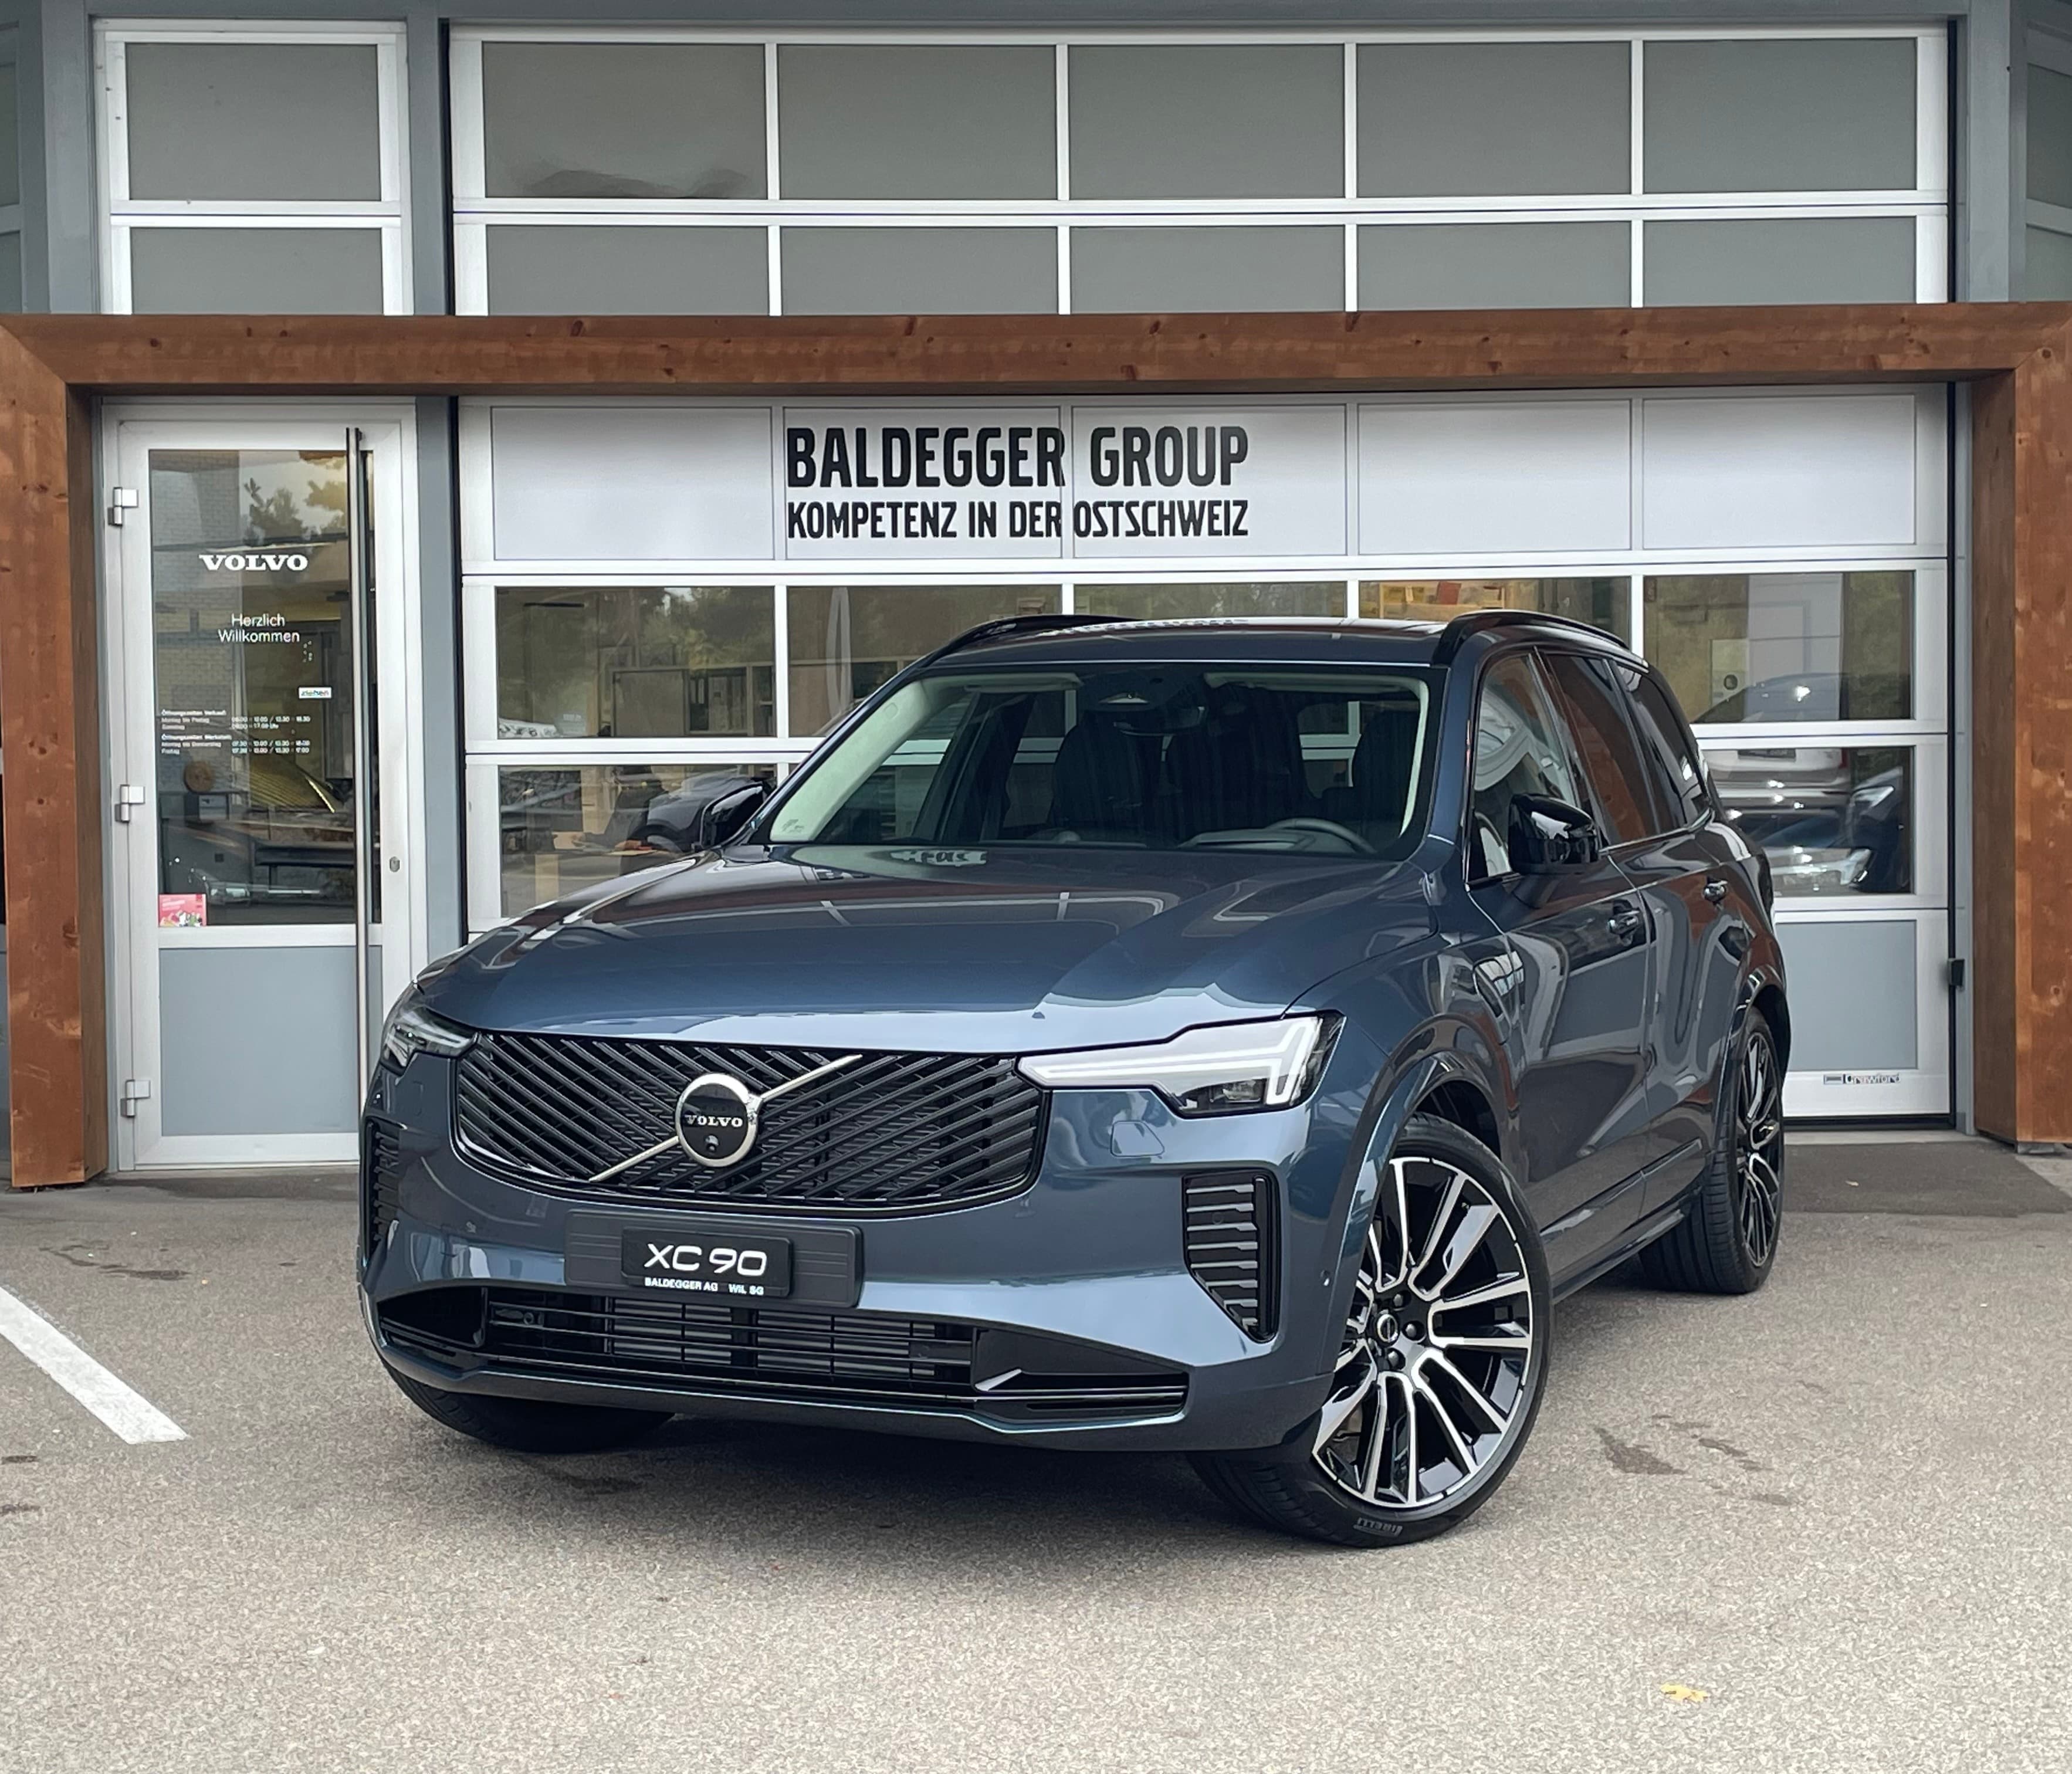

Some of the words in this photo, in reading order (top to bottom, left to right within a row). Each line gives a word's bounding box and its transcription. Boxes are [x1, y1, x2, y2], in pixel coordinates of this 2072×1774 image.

[787, 427, 1065, 487] BALDEGGER
[1090, 426, 1249, 487] GROUP
[787, 501, 957, 539] KOMPETENZ
[968, 501, 997, 539] IN
[1009, 501, 1062, 539] DER
[1074, 500, 1249, 538] OSTSCHWEIZ
[198, 554, 309, 571] VOLVO
[231, 613, 285, 627] Herzlich
[218, 629, 300, 642] Willkommen
[685, 1115, 743, 1128] VOLVO
[644, 1243, 703, 1271] XC
[709, 1248, 767, 1277] 90
[644, 1277, 702, 1291] BALDEGGER
[703, 1281, 719, 1292] AG
